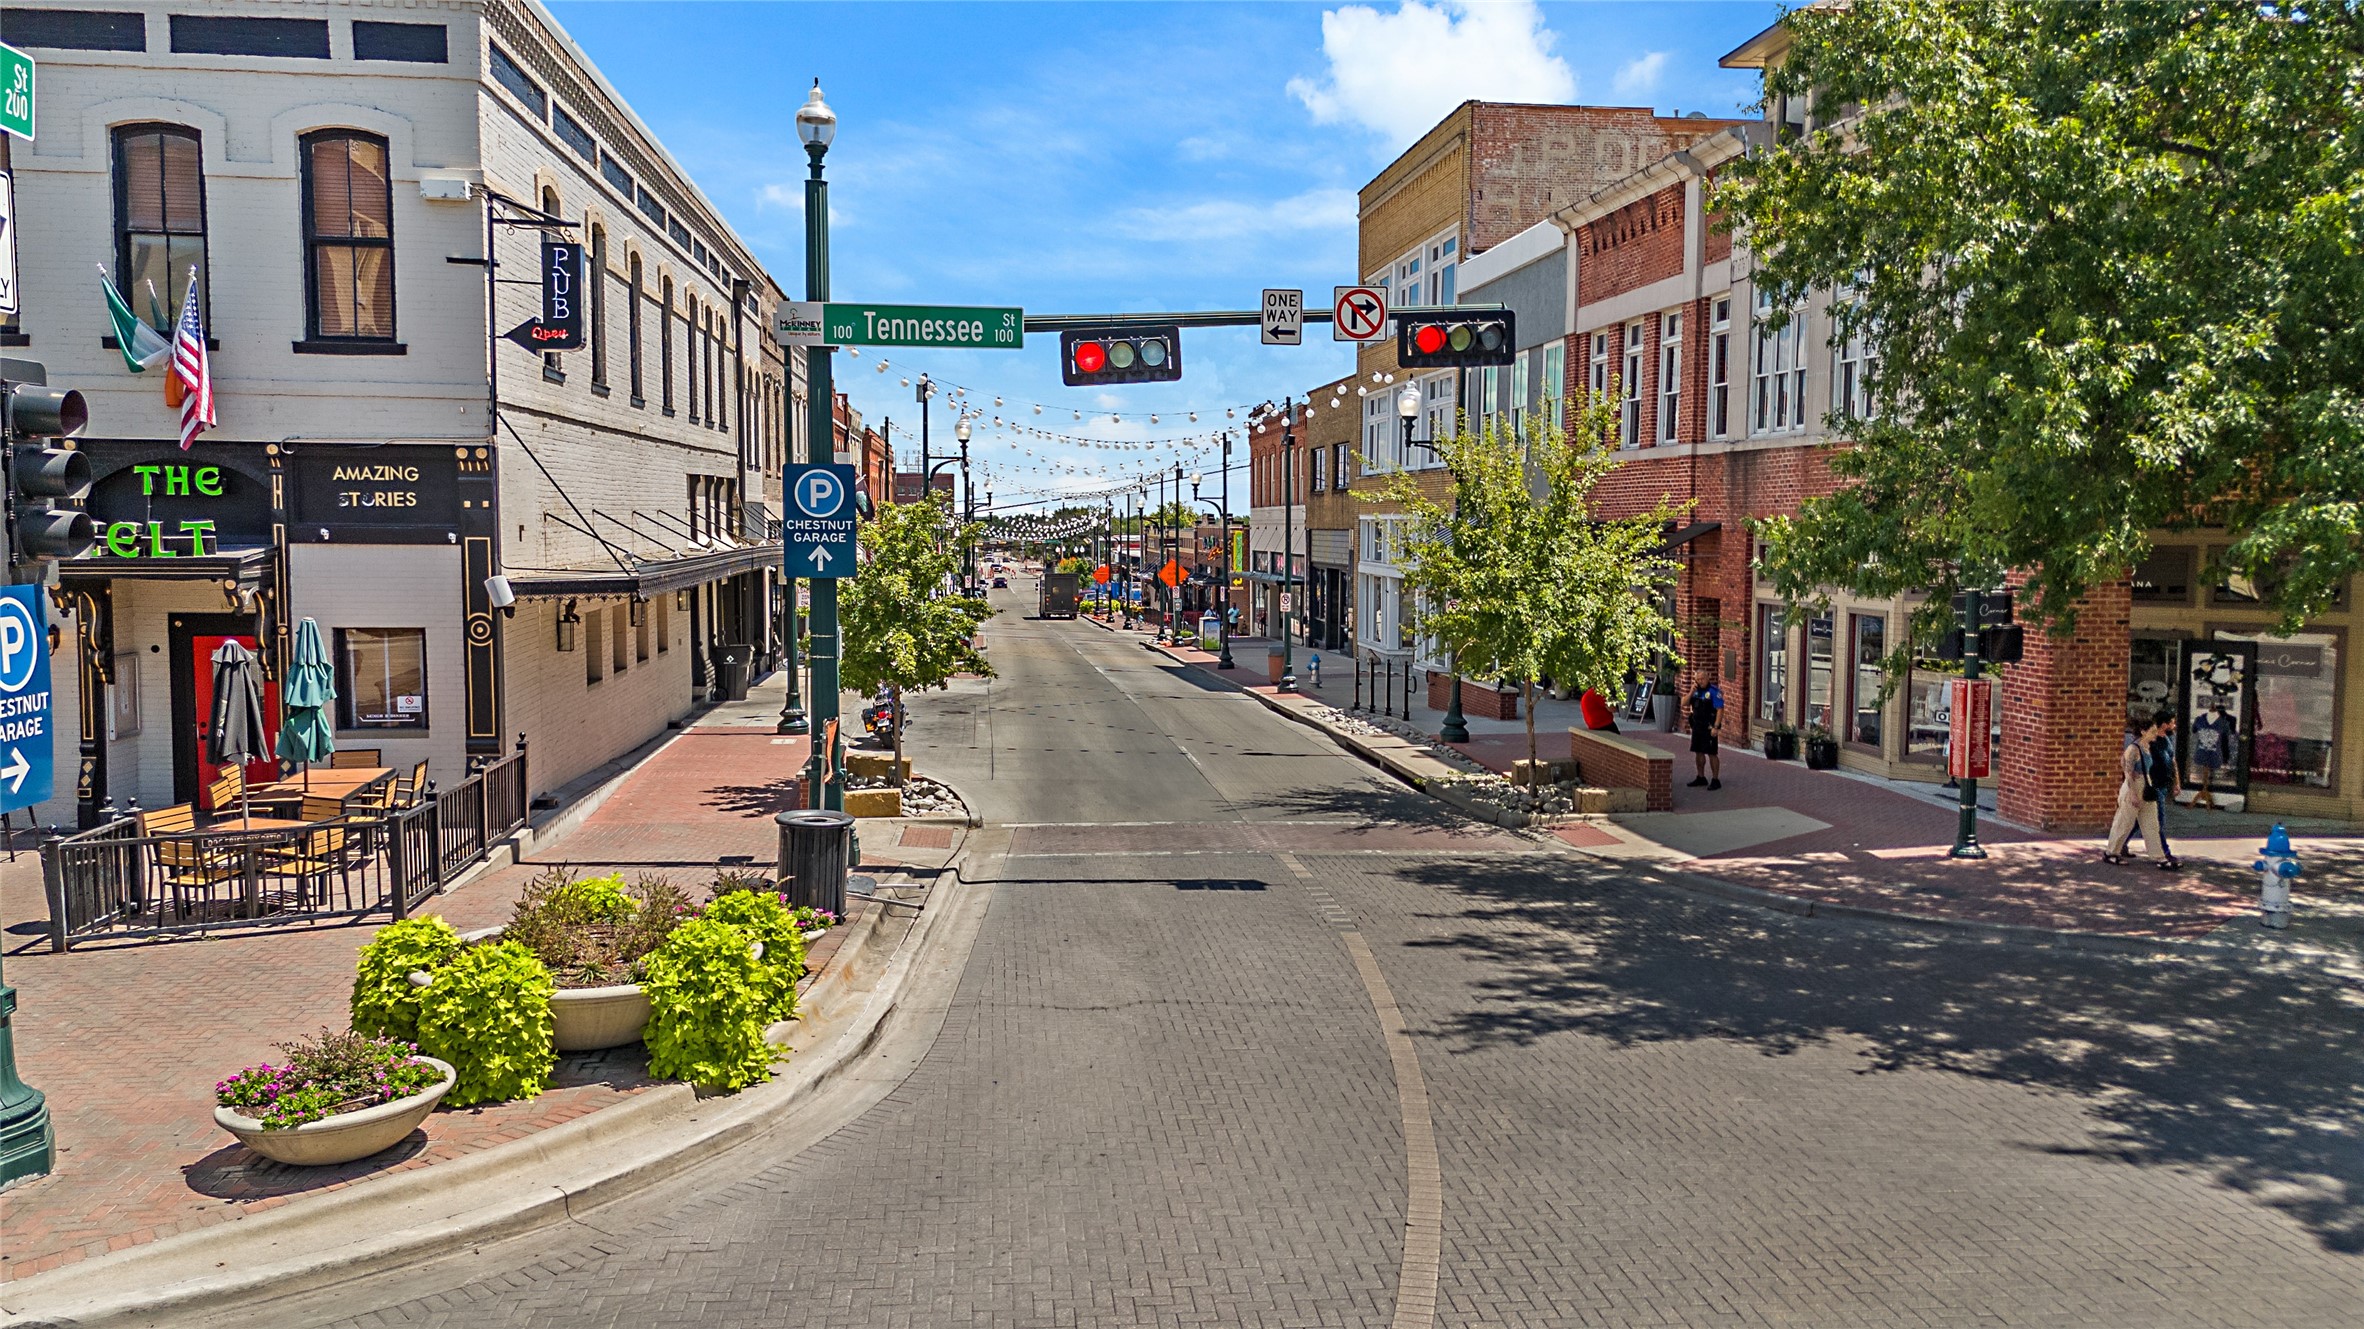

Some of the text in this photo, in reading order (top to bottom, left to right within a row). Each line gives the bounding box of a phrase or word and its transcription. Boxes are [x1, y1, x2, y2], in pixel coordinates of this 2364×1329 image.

[14, 63, 28, 92] St
[5, 88, 28, 121] 200
[552, 247, 571, 318] PUB
[1267, 293, 1298, 307] ONE
[833, 311, 1016, 342] 100 Tennessee St
[1266, 309, 1298, 322] WAY
[994, 329, 1014, 343] 100
[133, 465, 223, 496] THE
[332, 465, 420, 482] AMAZING
[339, 491, 418, 507] STORIES
[810, 478, 833, 508] P
[786, 519, 853, 531] CHESTNUT
[92, 520, 216, 558] ELT
[793, 532, 847, 543] GARAGE
[1979, 603, 2008, 617] Corner
[2278, 653, 2317, 668] Corner
[0, 691, 49, 718] ESTNUT
[0, 716, 44, 743] ARAGE
